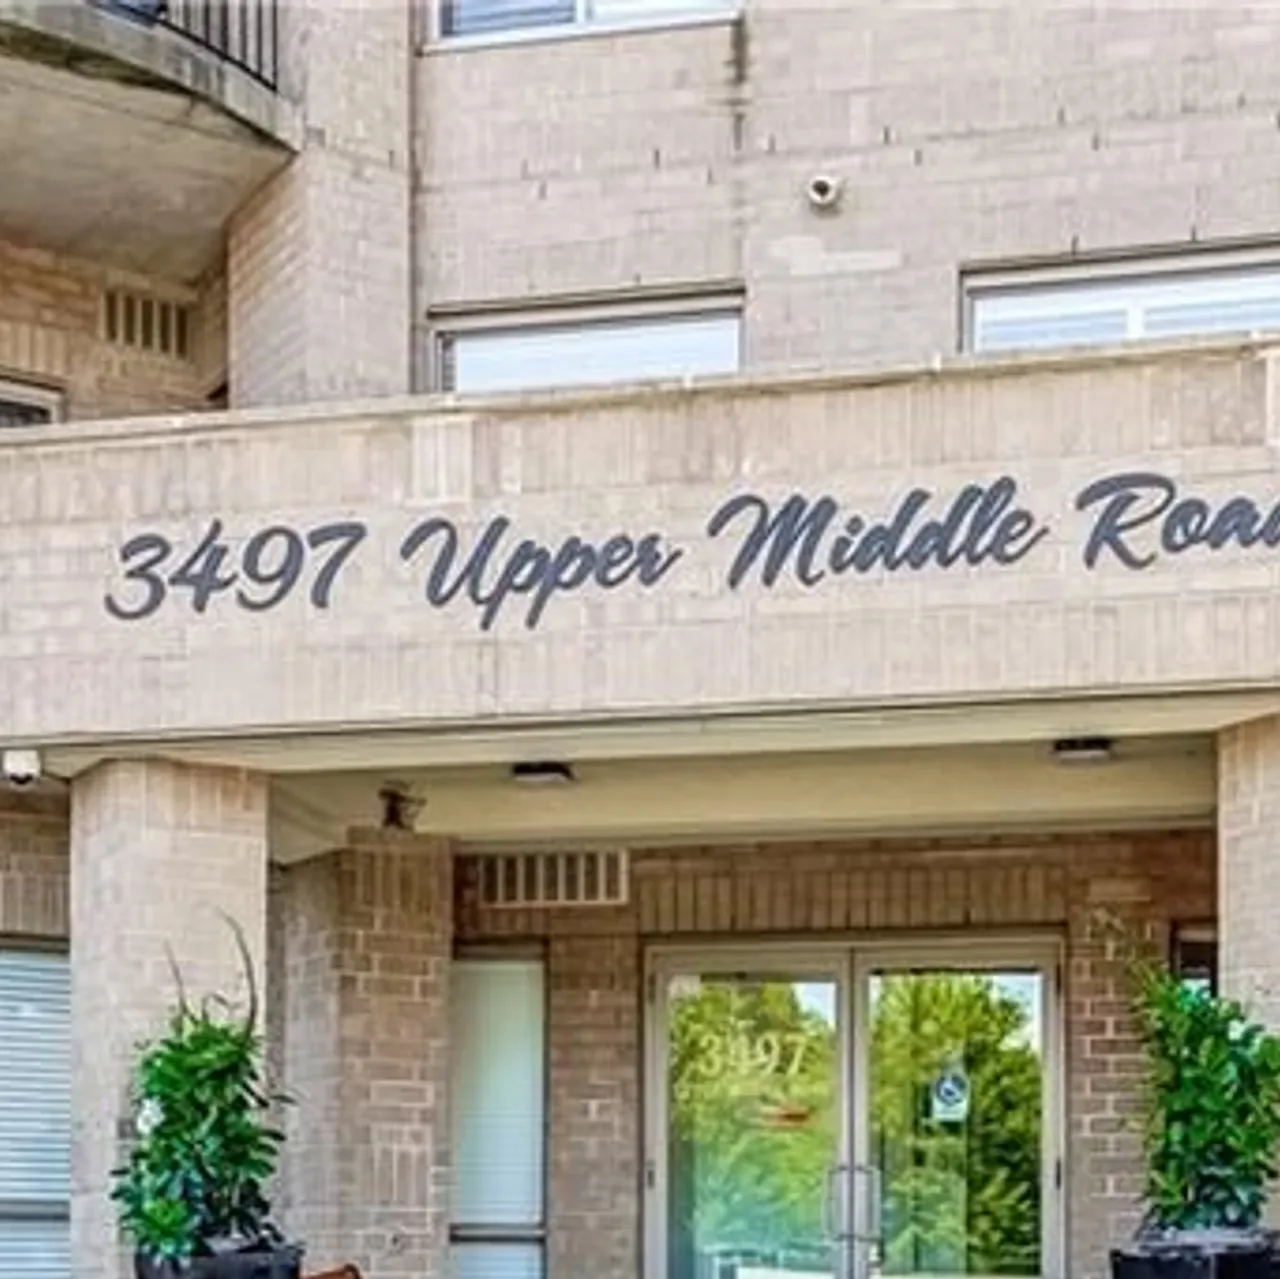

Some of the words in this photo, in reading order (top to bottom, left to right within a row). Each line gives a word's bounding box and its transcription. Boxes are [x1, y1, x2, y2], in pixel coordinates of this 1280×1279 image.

[103, 518, 368, 621] 3497
[399, 516, 684, 632] Upper
[706, 475, 1051, 591] Middle
